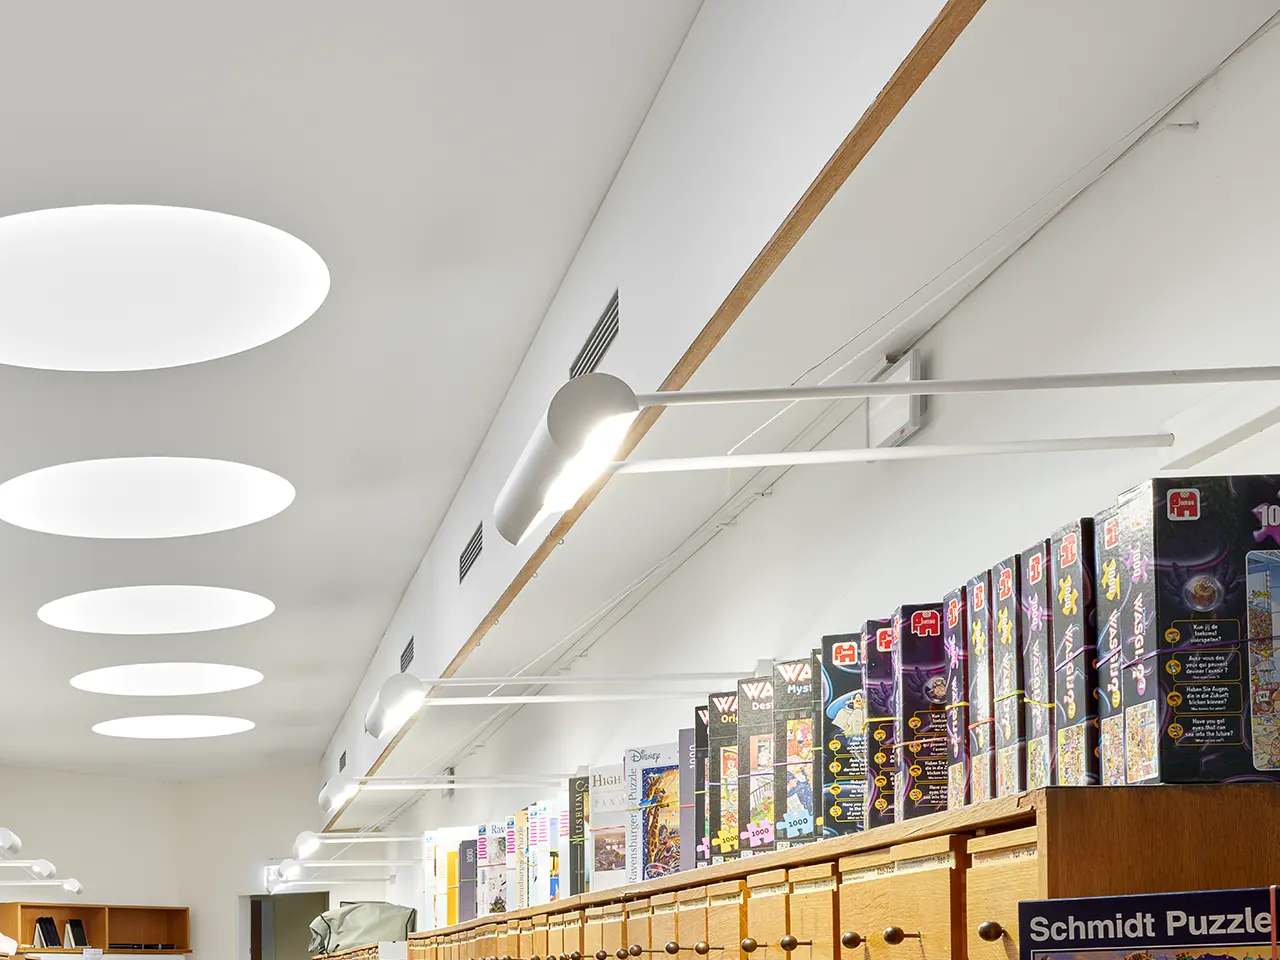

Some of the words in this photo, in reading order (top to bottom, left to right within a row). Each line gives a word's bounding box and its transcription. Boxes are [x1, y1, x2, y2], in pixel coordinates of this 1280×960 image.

[1173, 497, 1195, 508] Jumbo
[787, 684, 811, 693] Myst
[628, 767, 637, 801] Puzzle
[529, 821, 538, 846] 1000
[751, 827, 770, 837] 1000
[788, 817, 808, 827] 1000
[478, 837, 488, 861] 1000
[506, 830, 516, 854] 1000
[628, 813, 638, 884] Ravensburger
[1030, 911, 1156, 943] Schmidt
[1167, 907, 1272, 937] Puzzle
